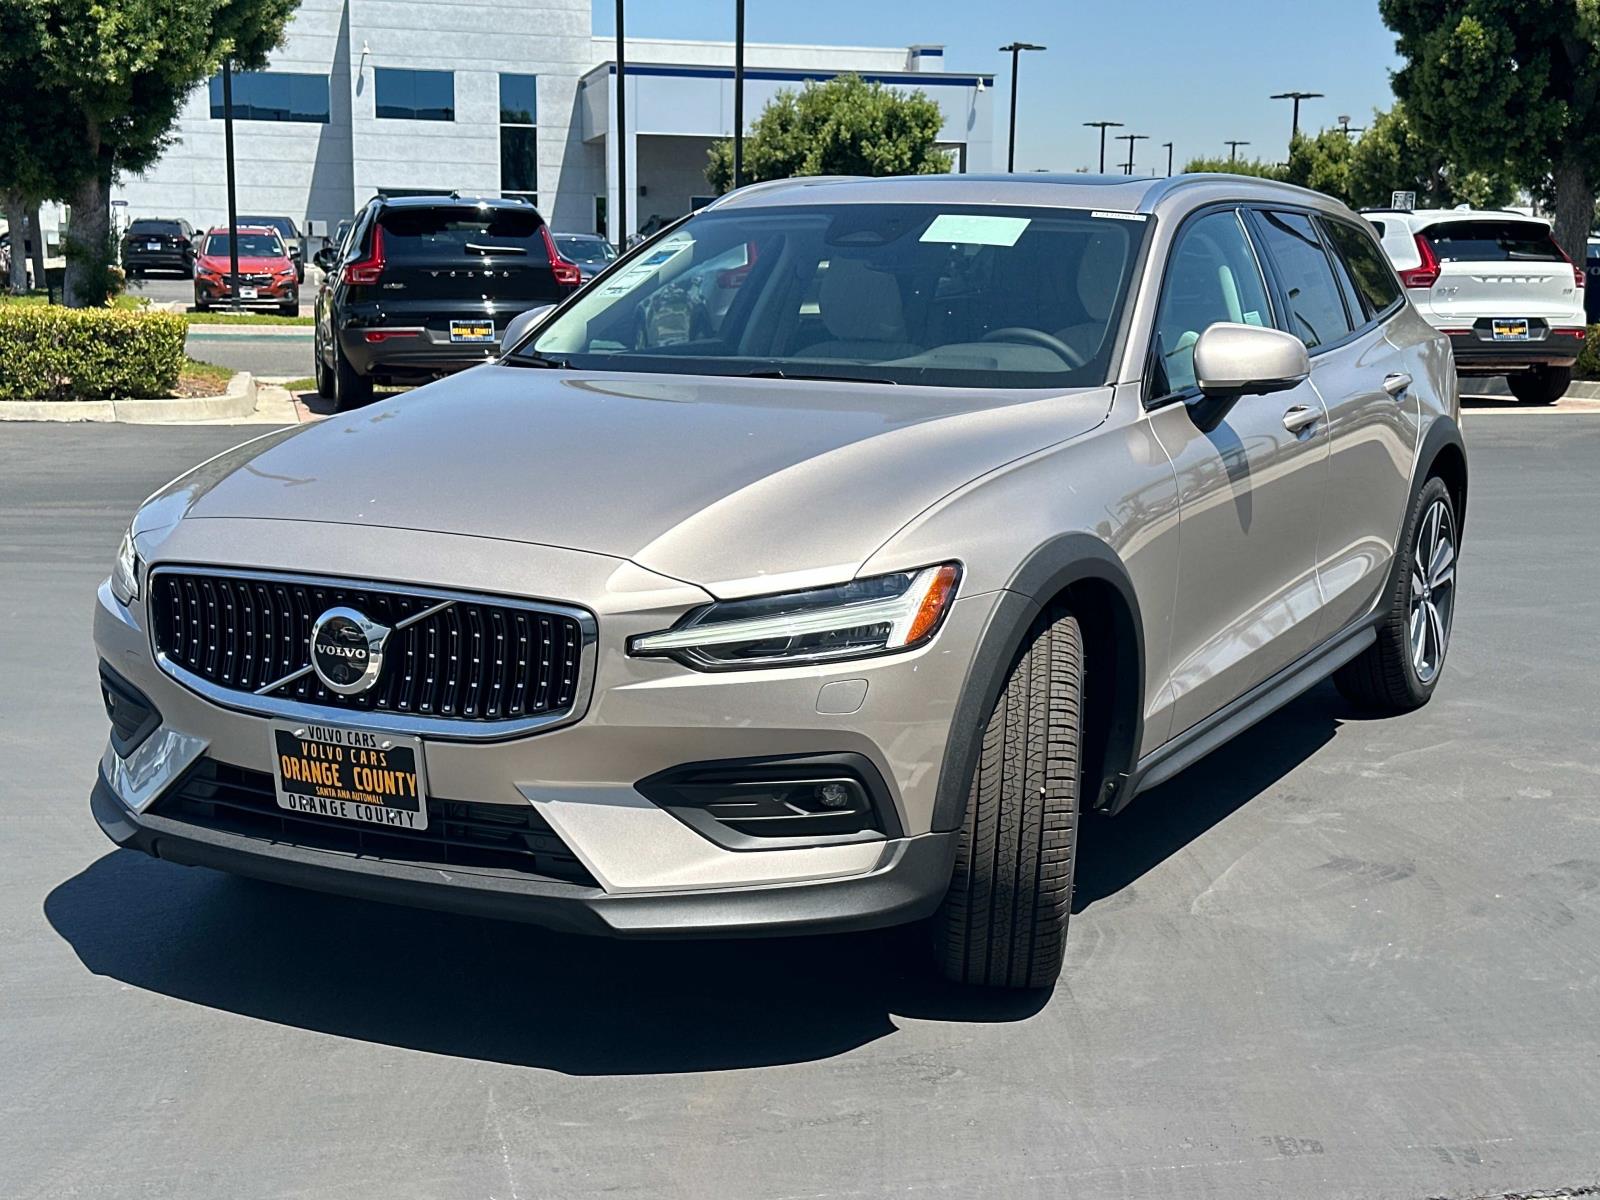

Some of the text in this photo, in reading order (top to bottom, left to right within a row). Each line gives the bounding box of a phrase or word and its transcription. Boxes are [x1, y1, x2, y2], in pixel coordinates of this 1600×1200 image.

[316, 643, 367, 659] VOLVO
[308, 725, 376, 748] VOLVO CARS
[301, 741, 387, 767] VOLVO CARS
[281, 755, 416, 798] ORANGE COUNTY
[315, 786, 384, 805] SANTA ANA AUTOMALL
[289, 793, 415, 828] ORANGE COUNTY
